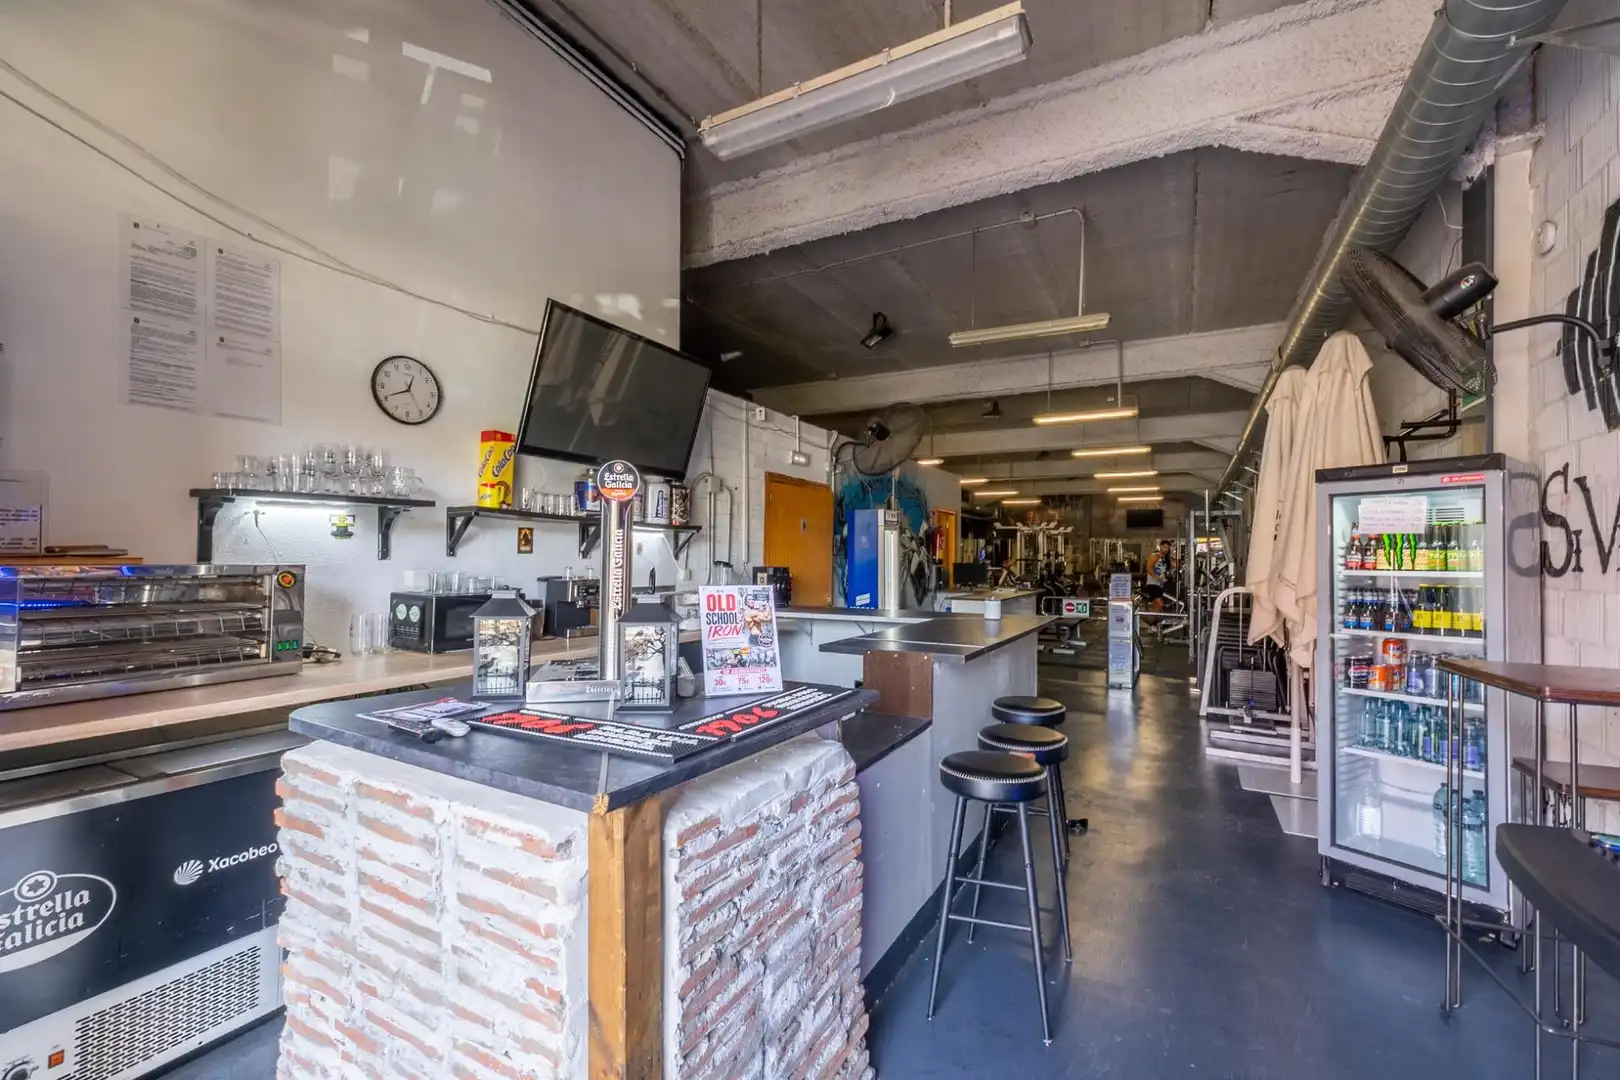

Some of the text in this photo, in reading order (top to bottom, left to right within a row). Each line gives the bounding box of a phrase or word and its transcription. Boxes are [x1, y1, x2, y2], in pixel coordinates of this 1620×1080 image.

[603, 472, 634, 481] Estrella
[604, 481, 633, 489] Galicia
[706, 593, 737, 612] OLD
[705, 612, 740, 626] SCHOOL
[707, 624, 742, 639] IRON
[208, 842, 278, 873] Xacobeo
[0, 889, 91, 932] strella
[0, 911, 84, 950] alicia
